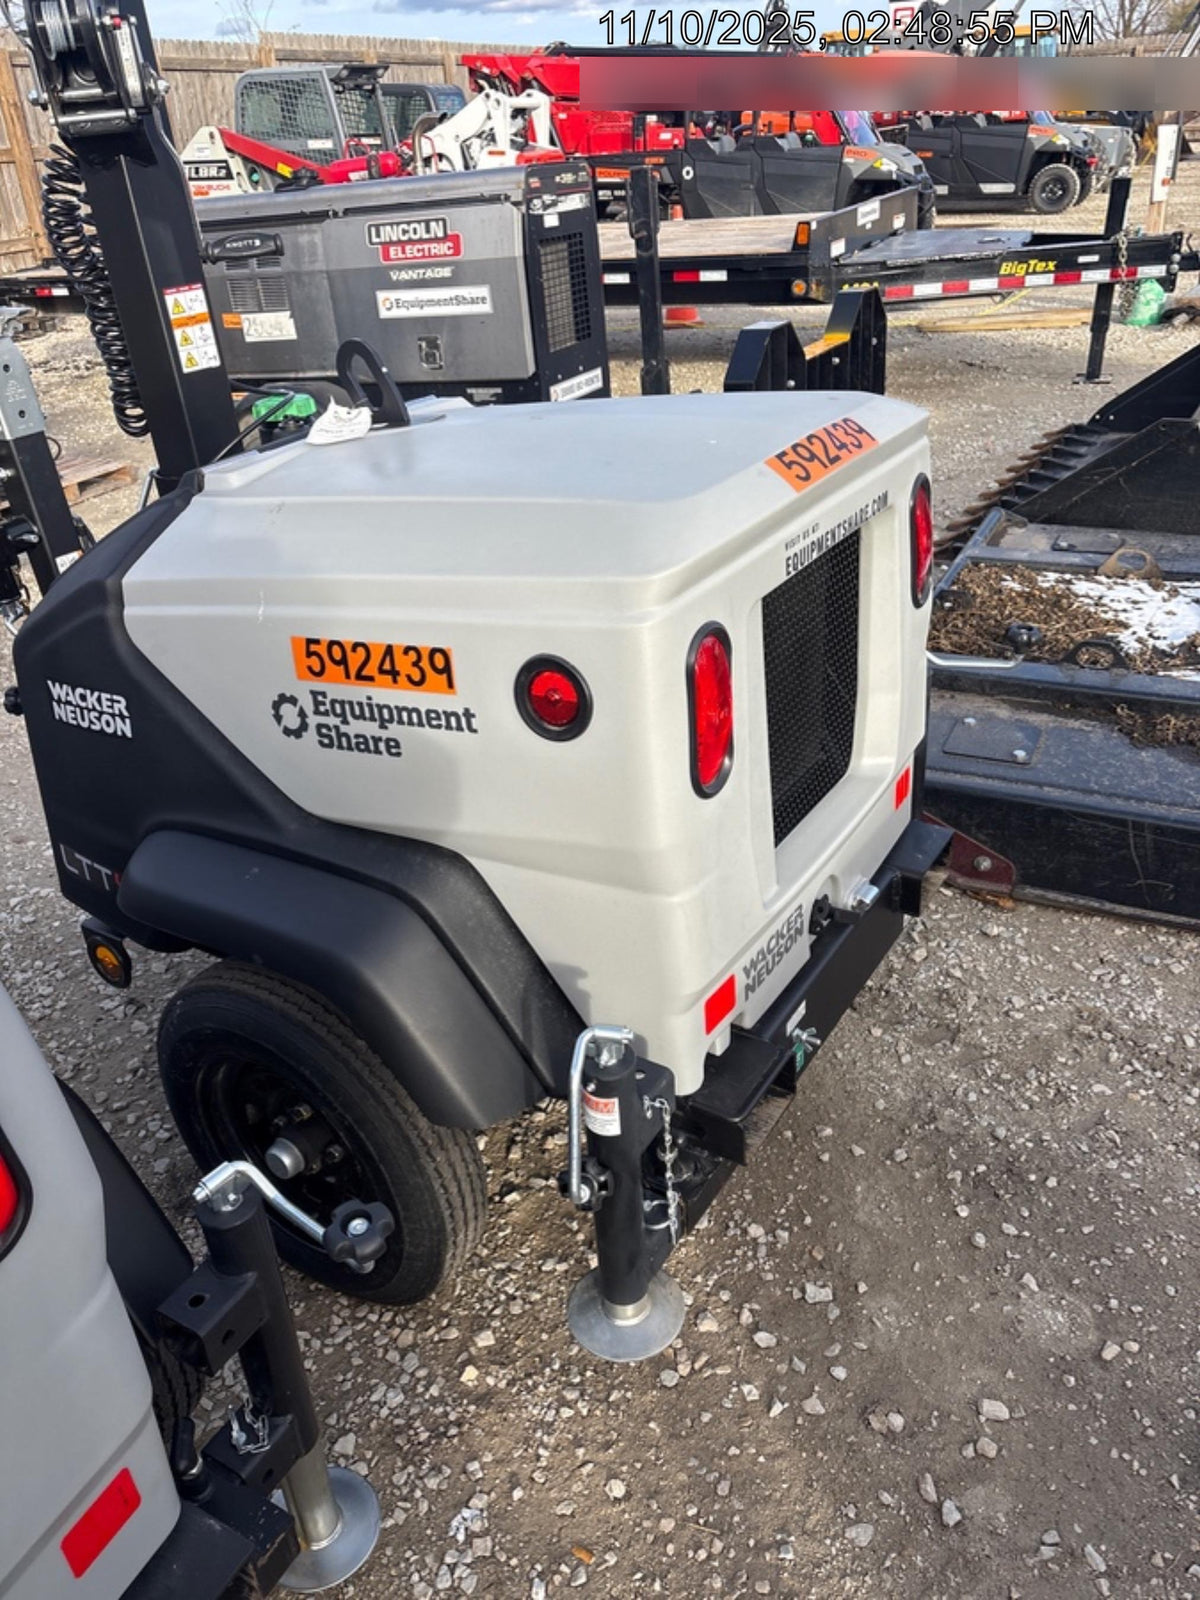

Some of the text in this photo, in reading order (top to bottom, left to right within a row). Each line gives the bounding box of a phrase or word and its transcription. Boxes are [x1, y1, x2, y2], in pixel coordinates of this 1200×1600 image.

[369, 220, 445, 244] LINCOLN
[388, 241, 455, 260] ELECTRIC
[388, 265, 456, 281] VANTAGE
[999, 258, 1058, 277] BigTex
[394, 294, 489, 312] EquipmentShare
[774, 416, 877, 483] 592439
[784, 490, 889, 577] EQUIPMENTSHARE.COM
[304, 637, 455, 690] 592439
[46, 679, 131, 717] WACKER
[308, 688, 479, 734] Equipment
[52, 700, 133, 739] NEUSON
[314, 722, 403, 758] Share
[742, 903, 804, 979] WACKER
[743, 919, 805, 1002] NEUSON
